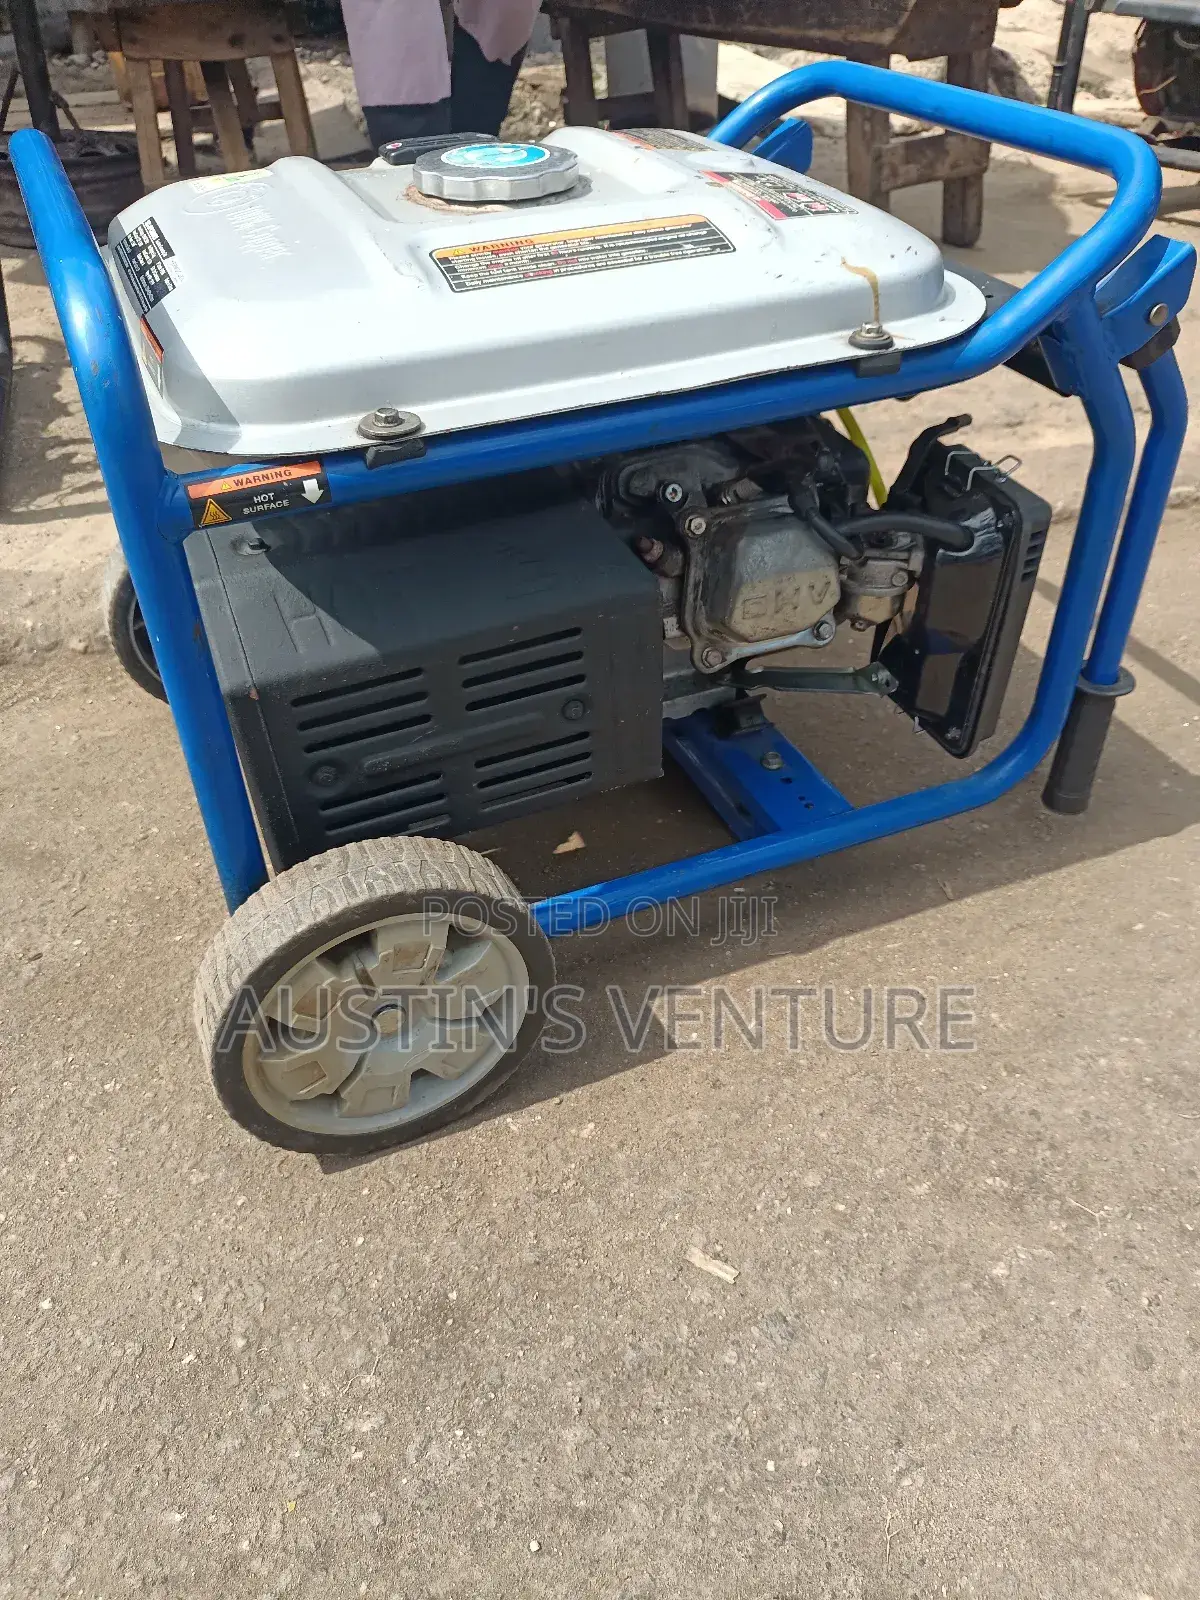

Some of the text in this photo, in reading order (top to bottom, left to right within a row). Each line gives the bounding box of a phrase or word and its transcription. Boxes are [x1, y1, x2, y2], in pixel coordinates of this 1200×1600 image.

[469, 239, 533, 251] WARNING
[233, 469, 292, 487] WARNING
[253, 493, 275, 504] HOT
[242, 500, 290, 515] SURFACE
